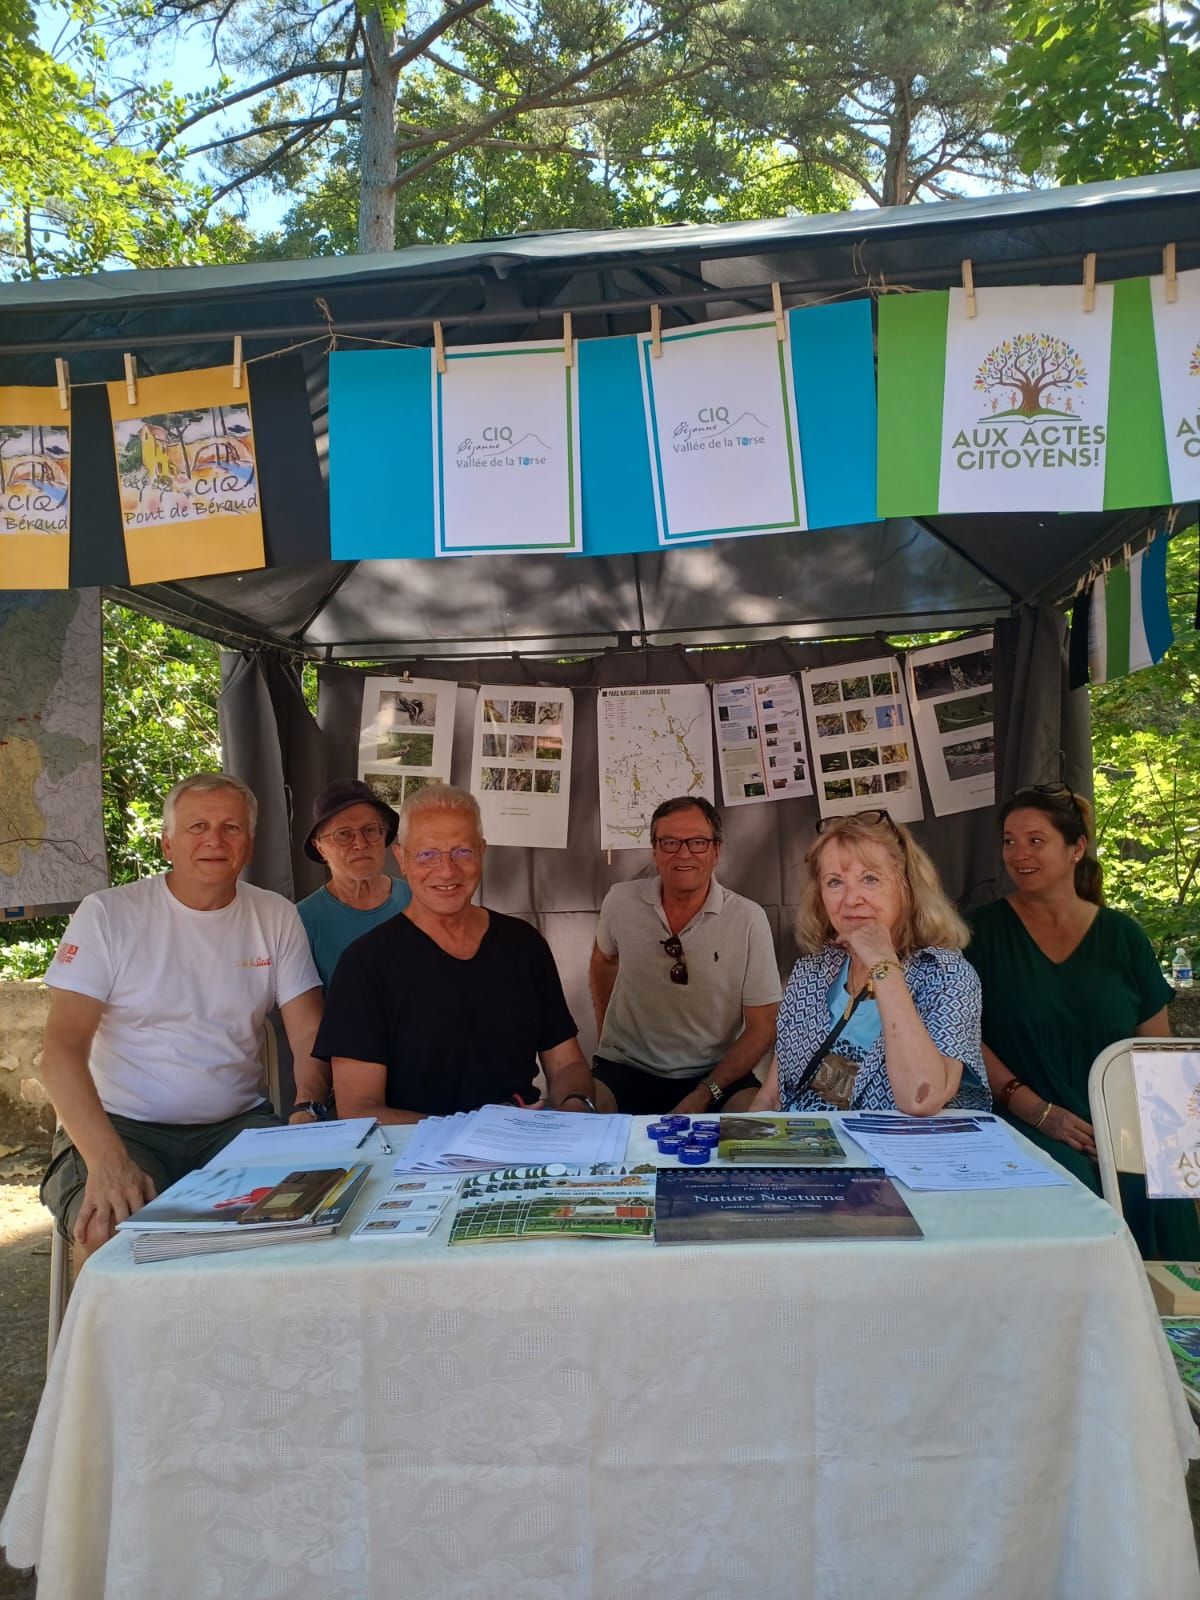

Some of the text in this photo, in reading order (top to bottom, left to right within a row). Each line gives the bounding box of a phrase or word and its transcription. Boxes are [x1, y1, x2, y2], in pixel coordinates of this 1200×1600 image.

[698, 406, 730, 425] CIQ
[482, 426, 513, 444] CIQ
[672, 434, 765, 453] Vallée de la Torse
[952, 425, 1106, 448] AUX ACTES
[456, 456, 546, 468] Vallée de la Torse
[956, 447, 1099, 470] CITOYENS!
[195, 474, 243, 495] CIQ
[8, 495, 56, 511] CIQ
[126, 493, 258, 525] Pont de Béraud
[3, 514, 68, 531] Béraud
[693, 1193, 845, 1203] Nature Nocturne
